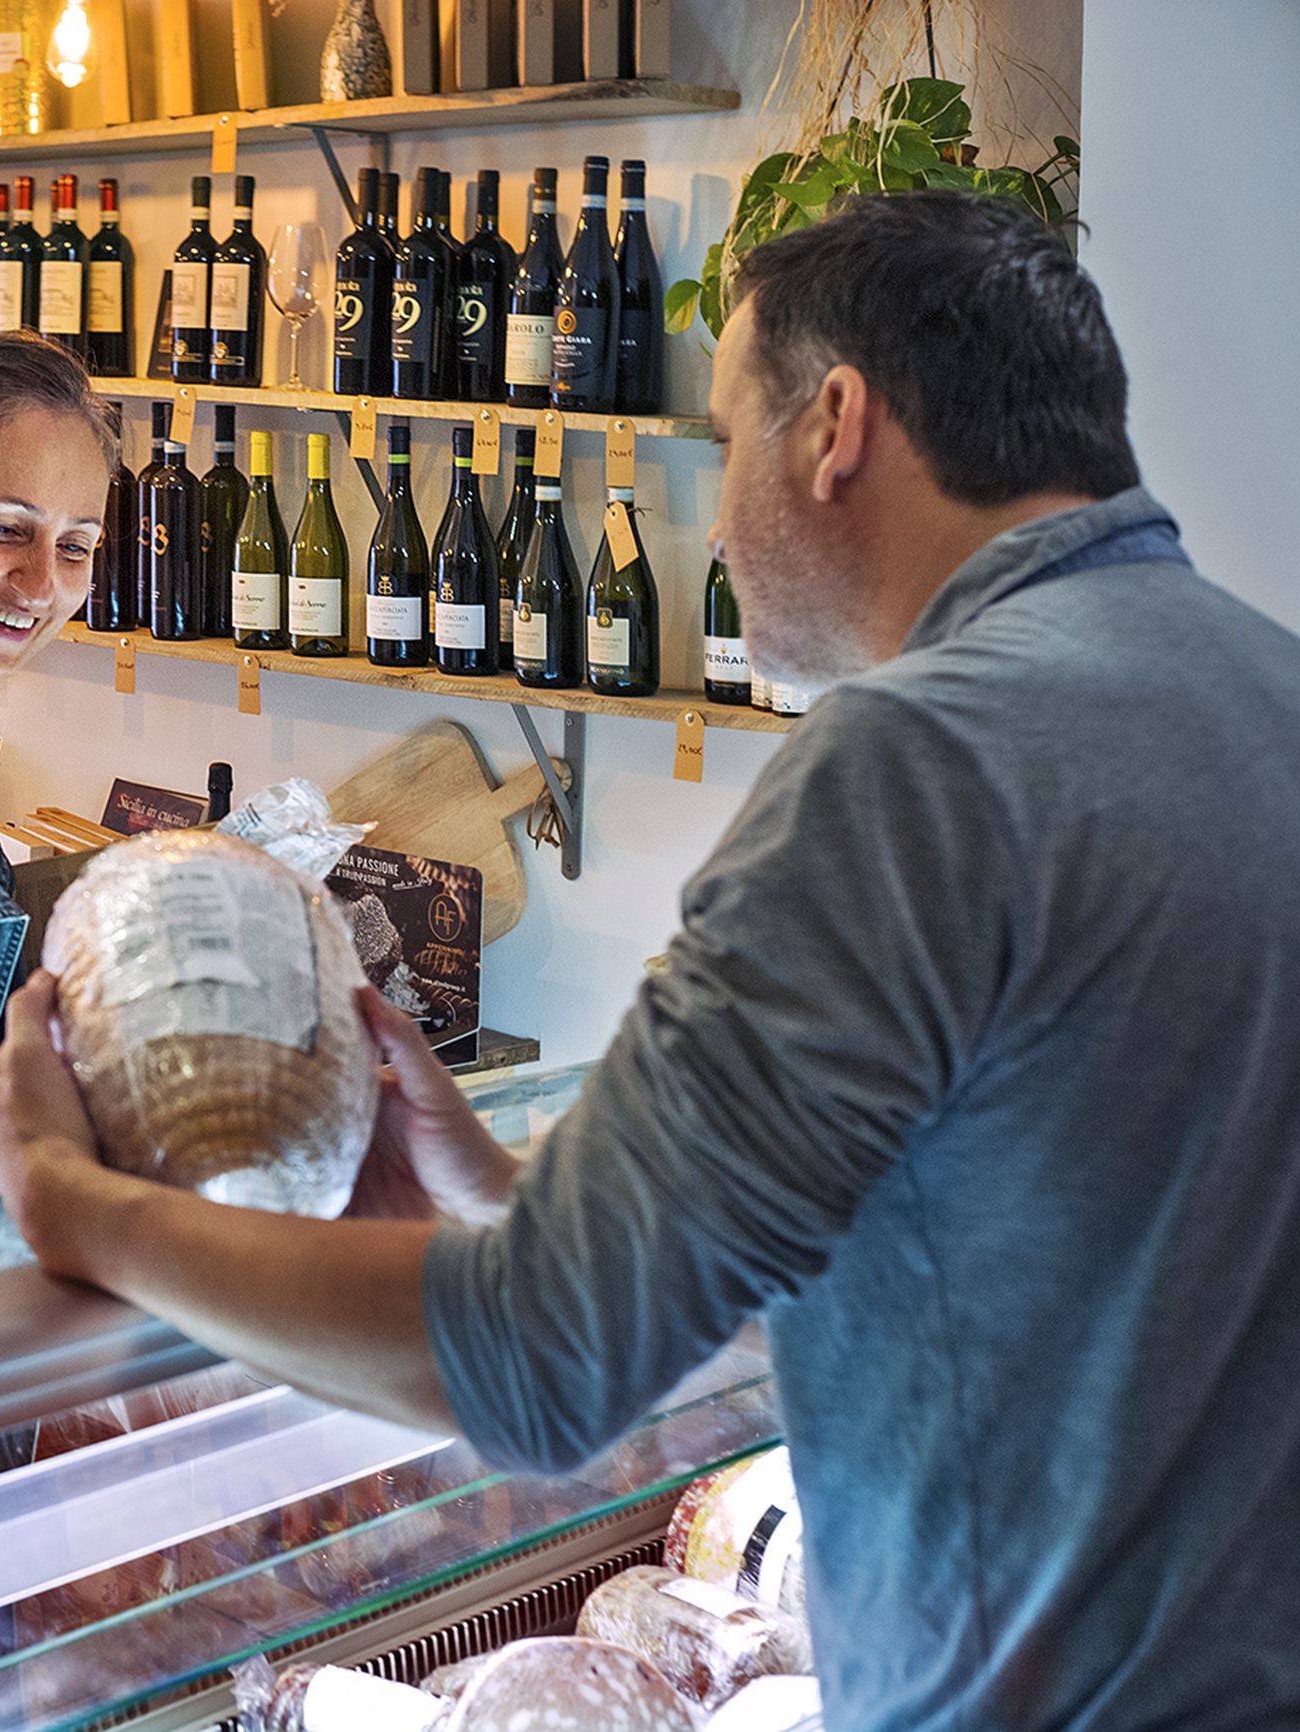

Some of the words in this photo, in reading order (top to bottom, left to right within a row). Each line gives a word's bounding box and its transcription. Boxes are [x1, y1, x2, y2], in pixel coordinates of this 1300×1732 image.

[391, 291, 421, 334] 29
[705, 652, 749, 666] FERRAR
[117, 793, 146, 814] Sicilia
[146, 803, 157, 818] in
[158, 808, 190, 828] cucina
[356, 857, 400, 877] PASSIONE
[356, 872, 387, 888] PASSION
